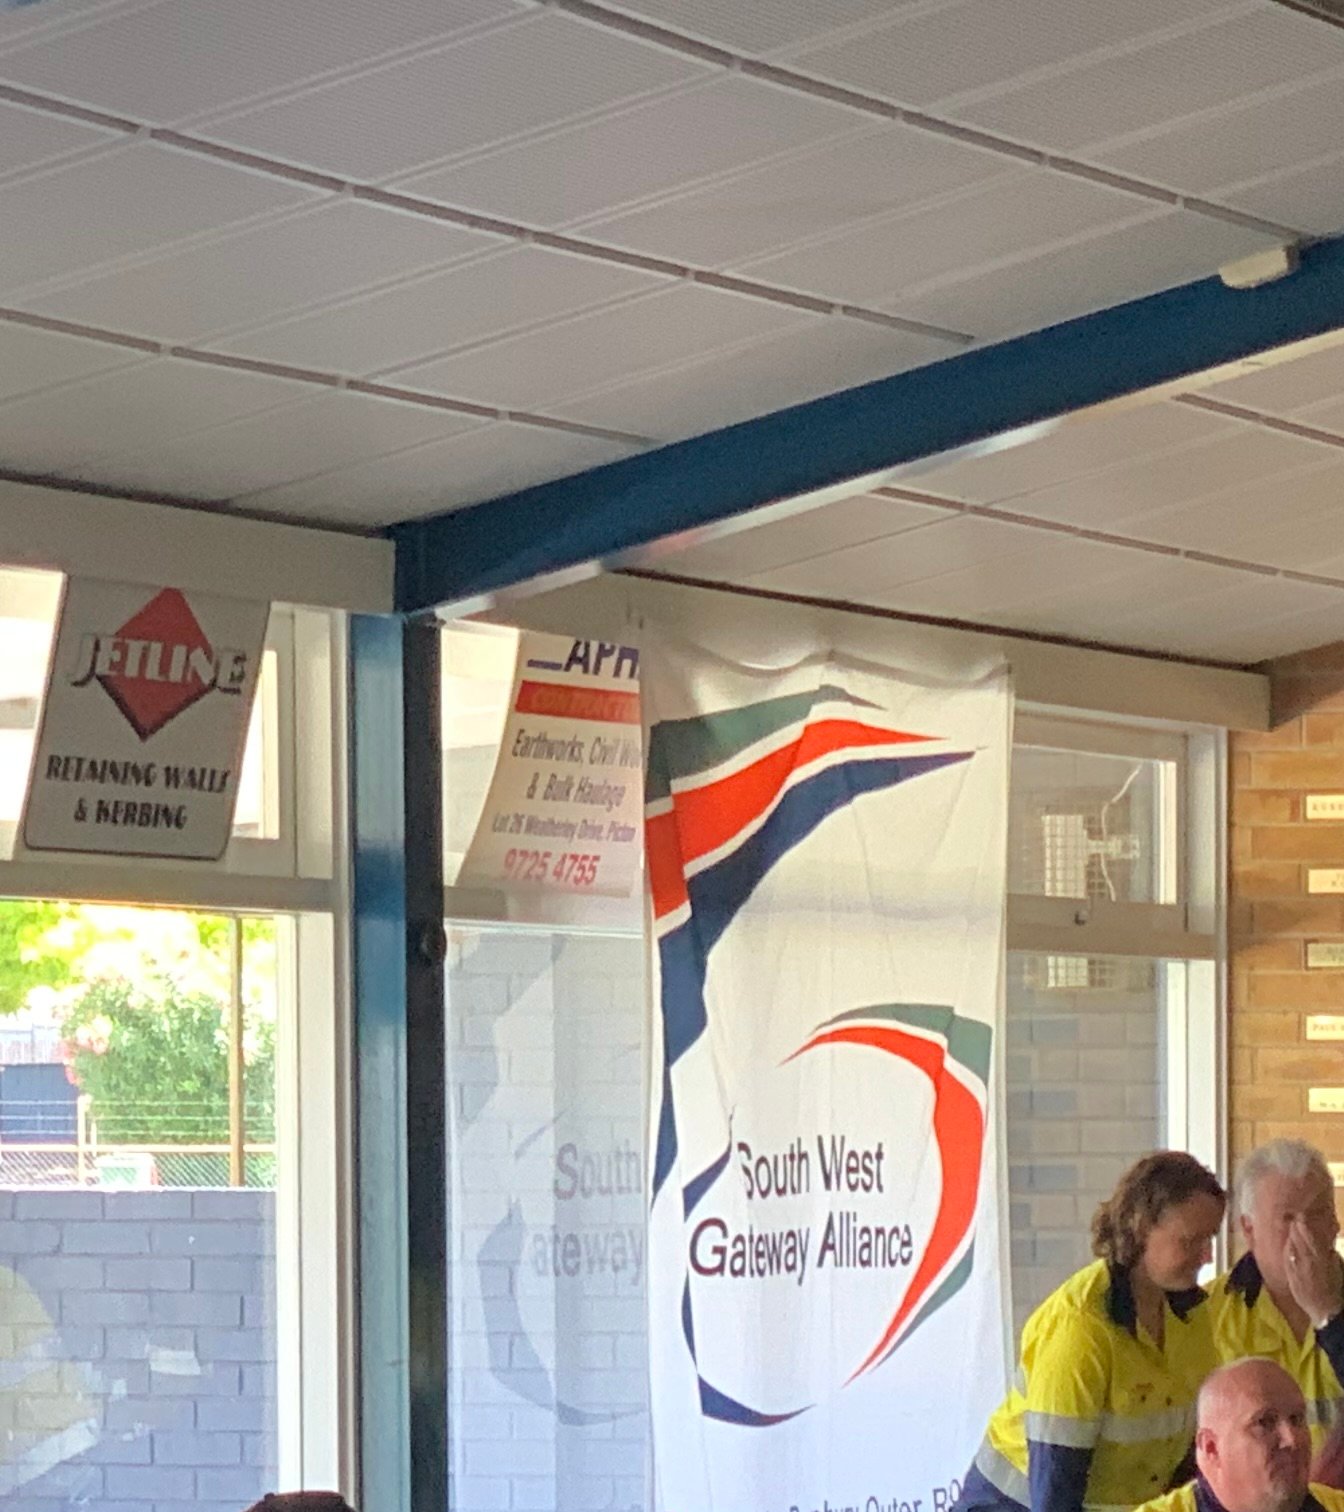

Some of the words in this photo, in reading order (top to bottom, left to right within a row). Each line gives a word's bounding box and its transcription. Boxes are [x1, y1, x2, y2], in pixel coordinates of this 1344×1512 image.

[71, 633, 247, 696] JETLINE
[46, 754, 156, 788] RETAINING
[163, 764, 231, 794] WALLS
[525, 772, 541, 800] &
[543, 773, 574, 804] Bulk
[574, 776, 627, 812] Haulage
[74, 797, 88, 824] &
[95, 798, 188, 830] KERBING
[504, 848, 552, 882] 9725
[553, 851, 601, 885] 4755
[737, 1136, 811, 1201] South
[816, 1134, 884, 1194] West
[532, 1222, 643, 1287] ateway
[689, 1216, 811, 1286] Gateway
[816, 1211, 913, 1268] Alliance
